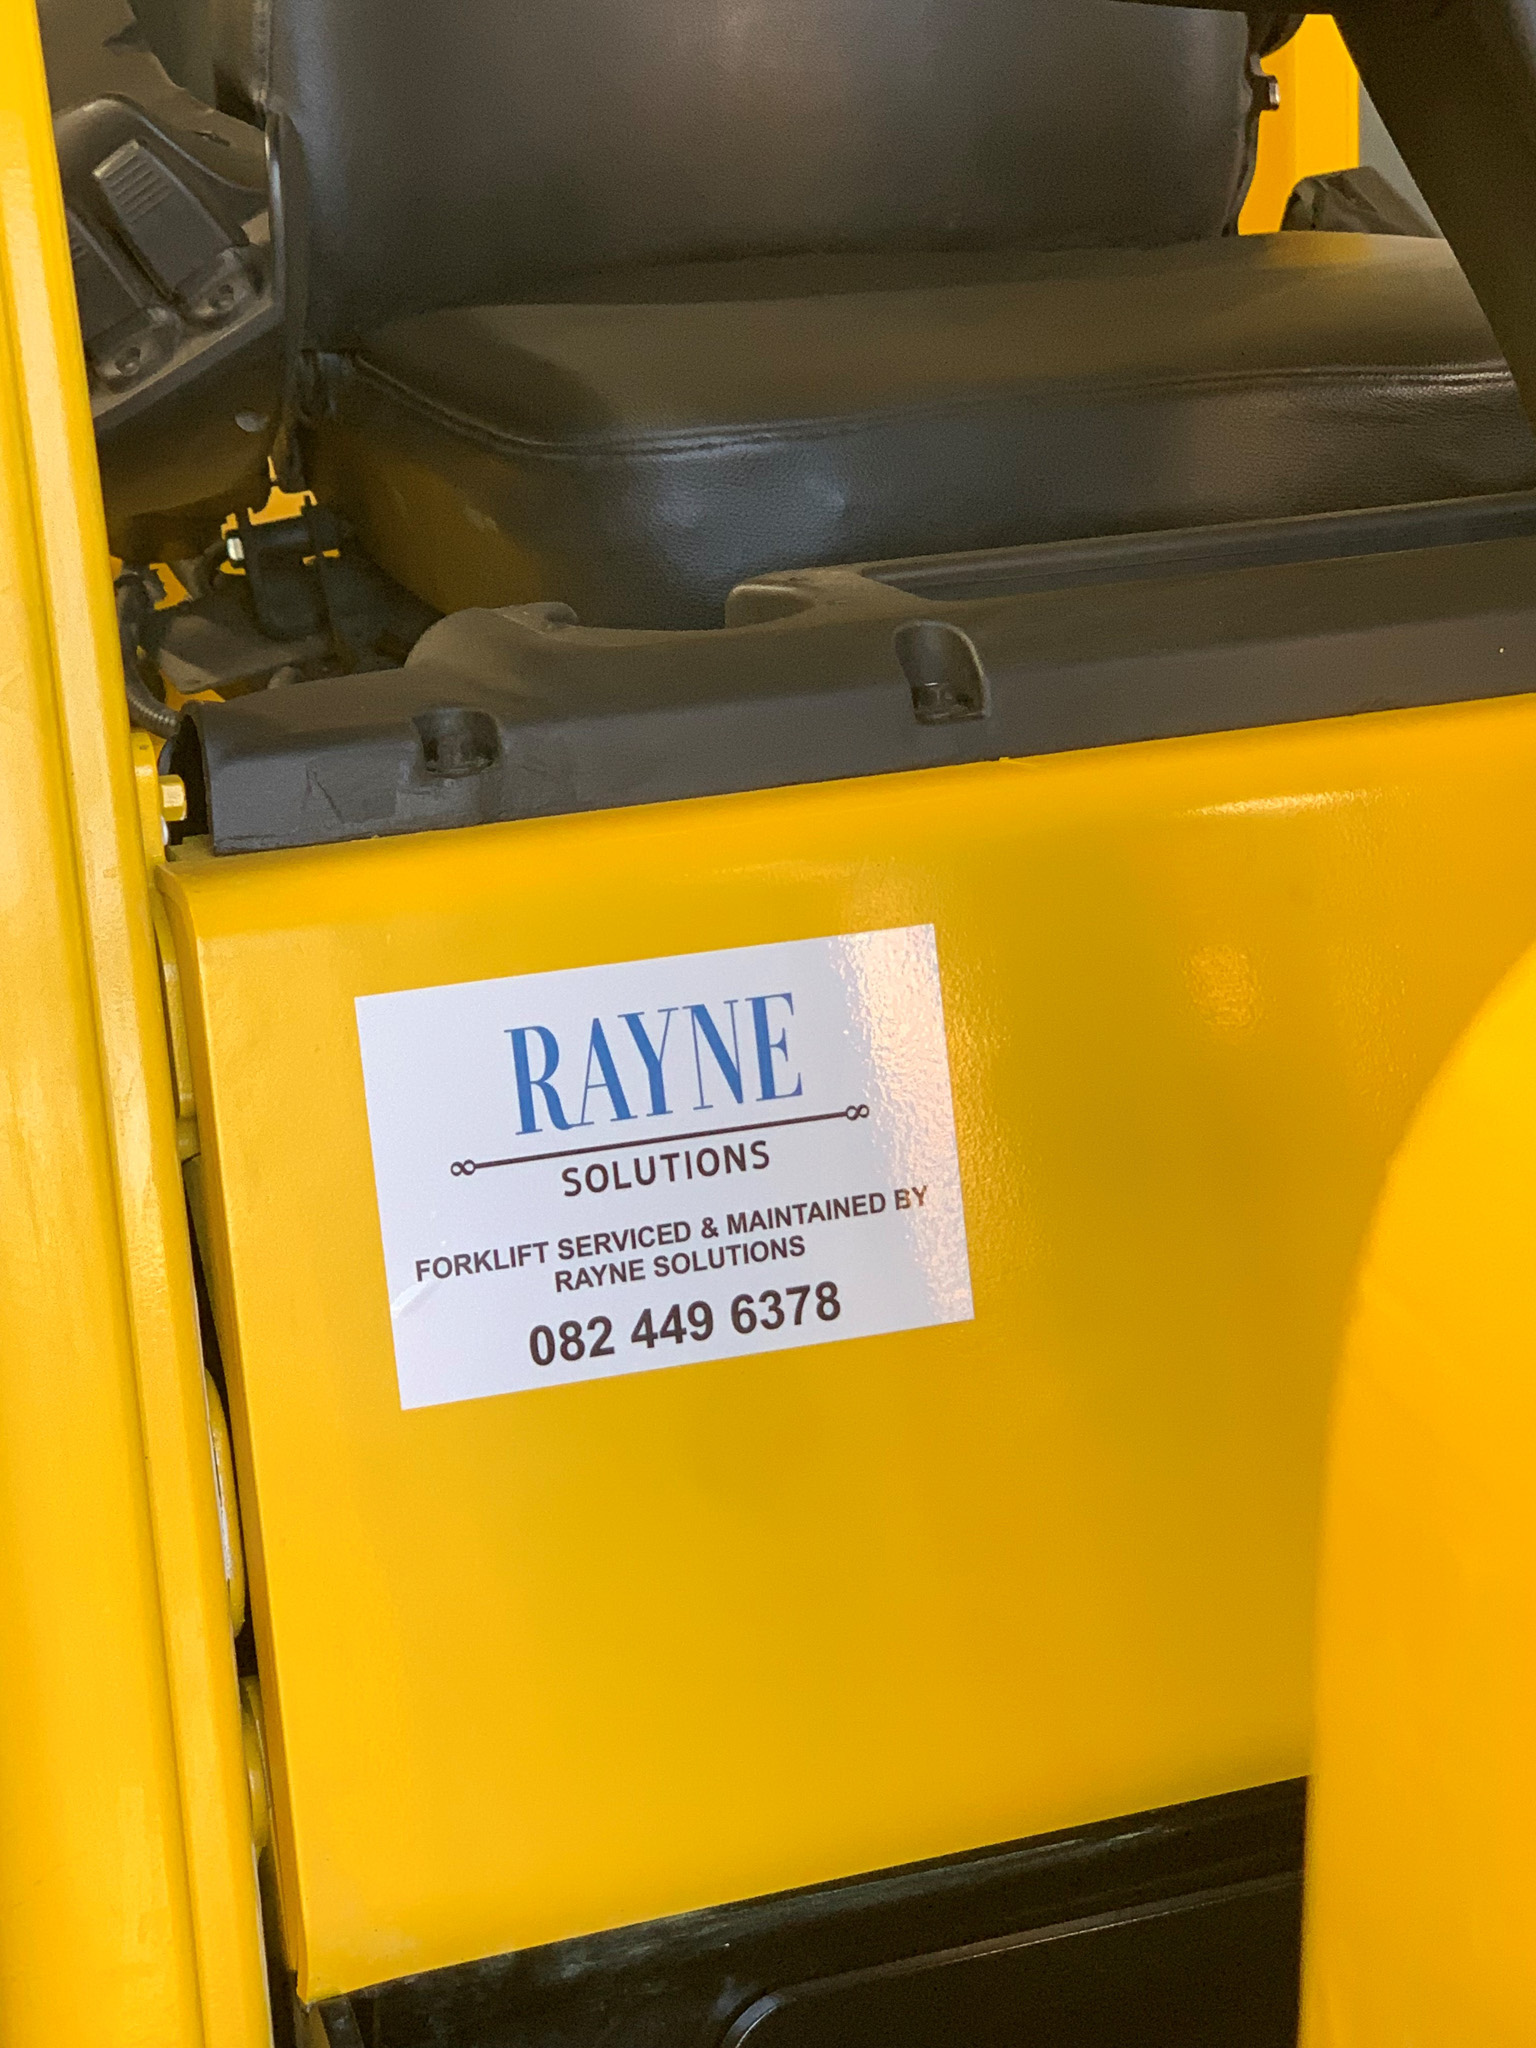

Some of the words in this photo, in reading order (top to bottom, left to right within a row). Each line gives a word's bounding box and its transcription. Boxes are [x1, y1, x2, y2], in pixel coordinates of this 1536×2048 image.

[504, 992, 803, 1135] RAYNE
[562, 1140, 770, 1197] SOLUTIONS
[415, 1241, 549, 1282] FORKLIFT
[558, 1220, 692, 1261] SERVICED
[701, 1217, 720, 1239] &
[727, 1192, 886, 1237] MAINTAINED
[894, 1185, 928, 1209] BY
[555, 1257, 646, 1293] RAYNE
[653, 1235, 806, 1277] SOLUTIONS
[529, 1317, 615, 1366] 082
[631, 1301, 714, 1349] 449
[730, 1281, 841, 1331] 6378
